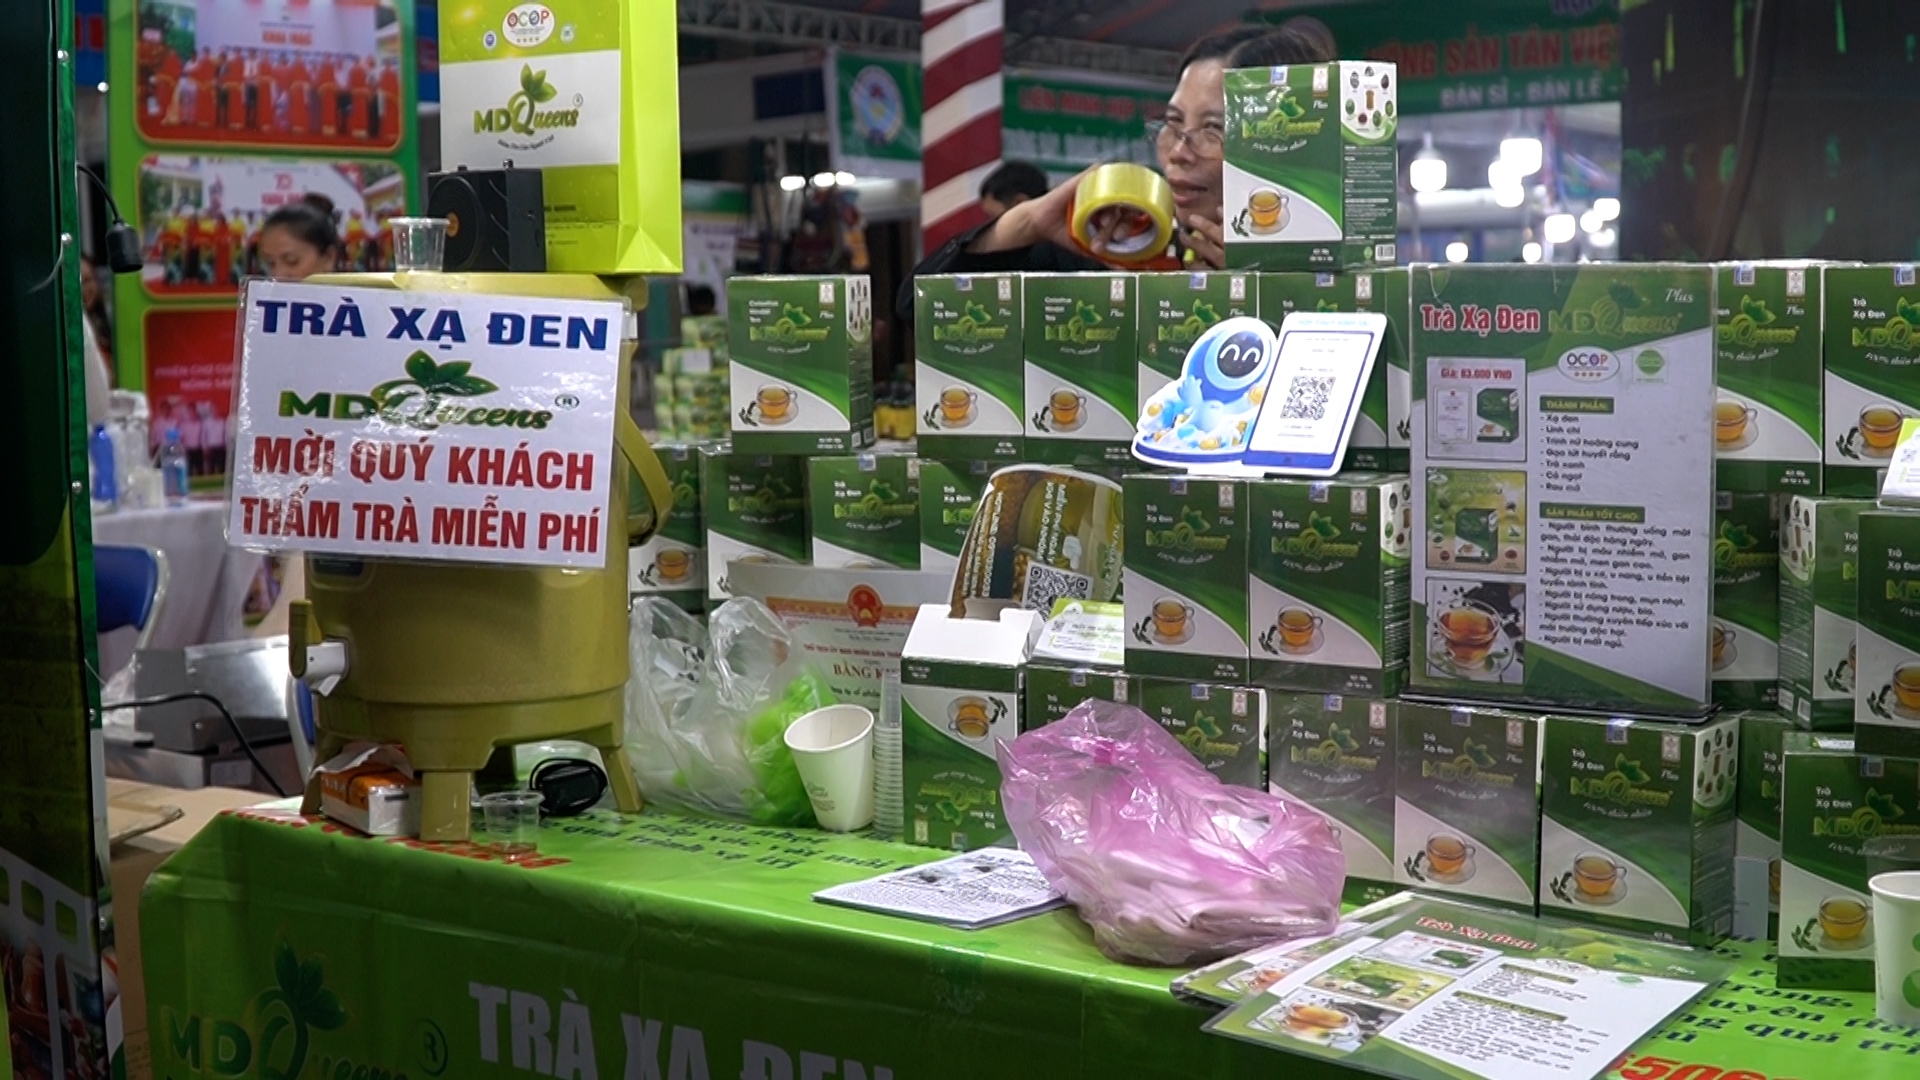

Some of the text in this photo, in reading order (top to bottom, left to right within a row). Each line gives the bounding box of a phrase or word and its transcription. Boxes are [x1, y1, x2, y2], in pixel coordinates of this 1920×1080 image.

[507, 9, 549, 28] OCOP
[1445, 24, 1500, 76] SẢN
[1508, 24, 1563, 69] TÂN
[1440, 83, 1483, 108] BÁN
[1526, 78, 1571, 102] BÁN
[1665, 287, 1694, 303] Plus
[256, 296, 608, 351] TRÀ XẠ ĐEN
[1420, 303, 1455, 331] Trà
[1460, 303, 1491, 337] Xạ
[1496, 304, 1541, 332] Đen
[1567, 352, 1608, 366] OCOP
[253, 428, 594, 491] MỜI QUÝ KHÁCH
[352, 496, 420, 544] TRÀ
[431, 495, 526, 550] MIỄN
[538, 506, 600, 554] PHÍ
[469, 981, 598, 1080] TRÀ
